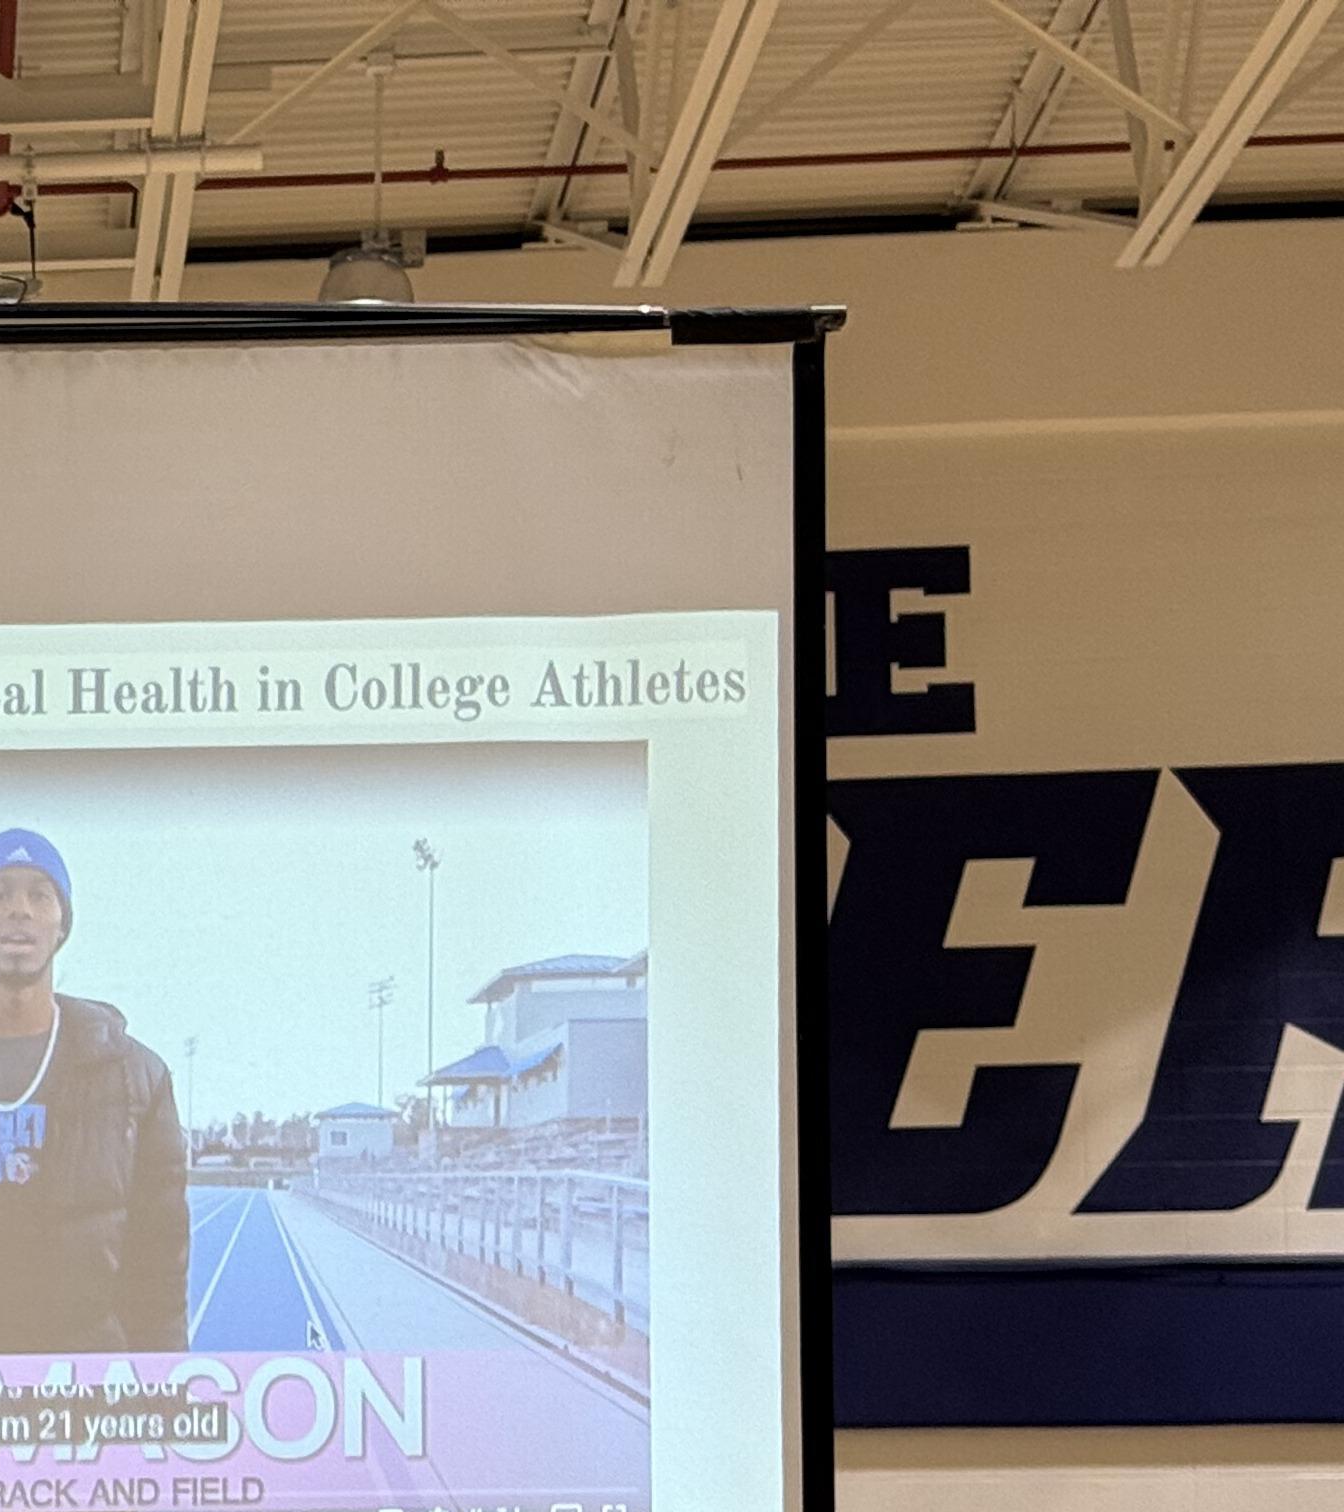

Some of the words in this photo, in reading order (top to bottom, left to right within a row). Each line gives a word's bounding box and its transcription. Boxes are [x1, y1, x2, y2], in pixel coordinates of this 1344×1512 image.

[67, 666, 238, 715] Health
[257, 665, 303, 712] in
[324, 661, 511, 721] College
[530, 658, 747, 708] Athletes
[38, 1408, 73, 1440] 21
[84, 1410, 164, 1448] years
[173, 1406, 220, 1438] old
[89, 1478, 161, 1507] AND
[172, 1476, 265, 1506] FIELD
